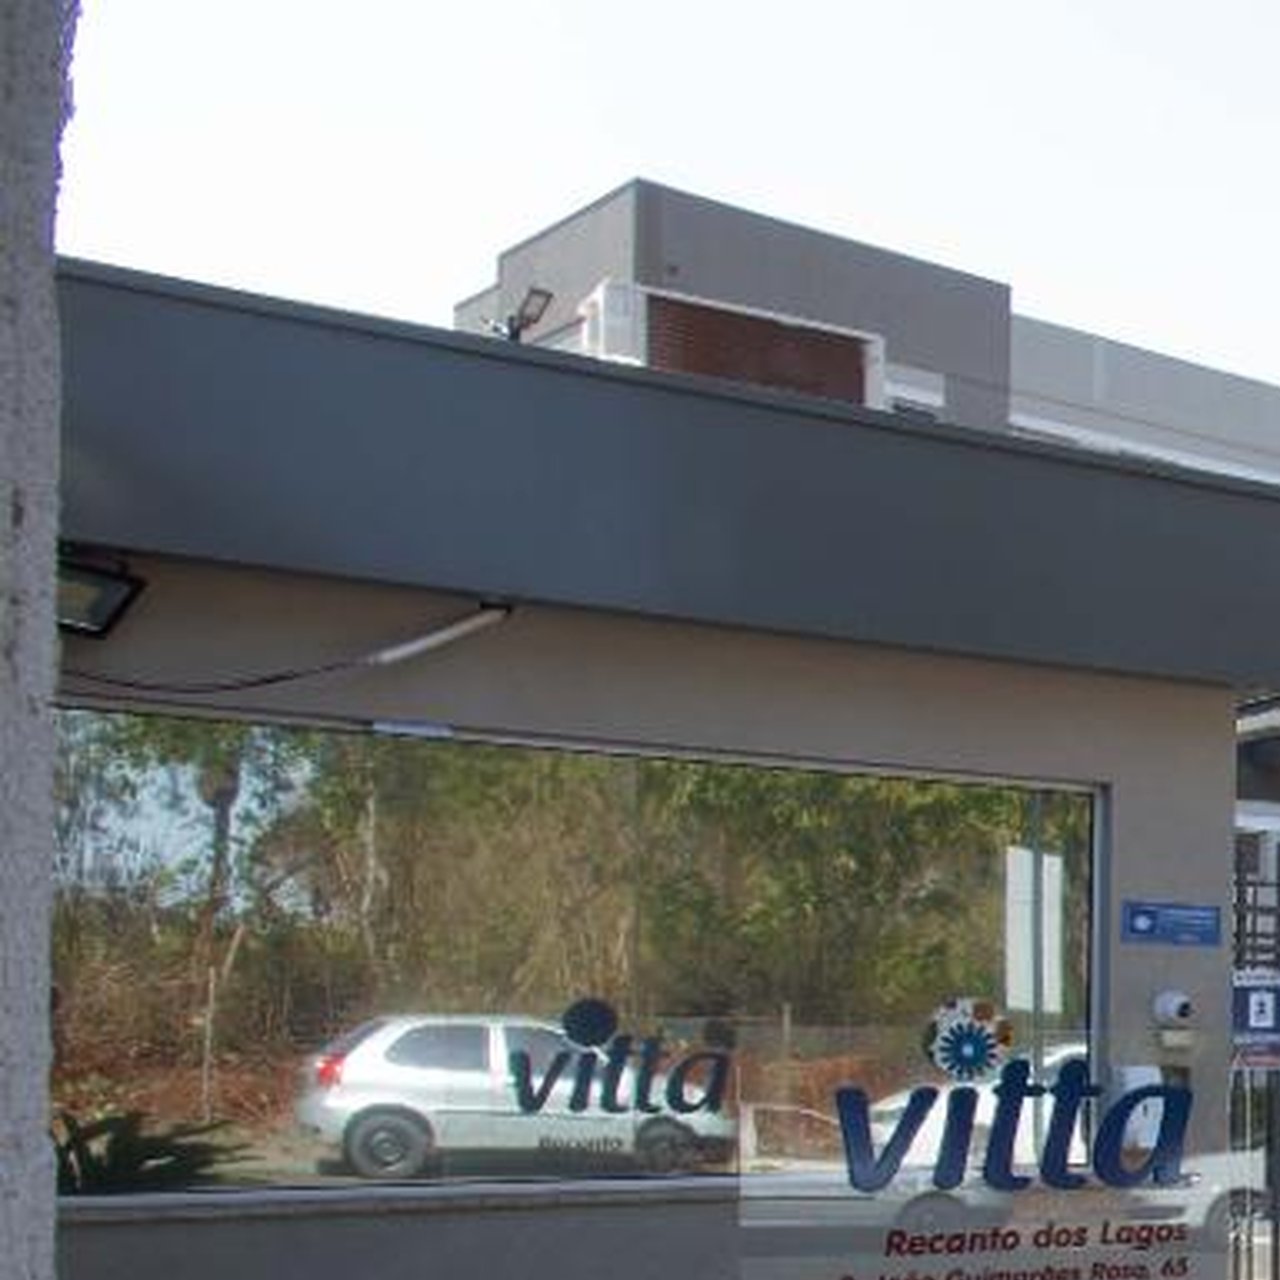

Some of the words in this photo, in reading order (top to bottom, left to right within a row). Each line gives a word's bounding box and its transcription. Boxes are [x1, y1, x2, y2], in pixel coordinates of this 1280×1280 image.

[510, 1000, 729, 1114] vitta
[836, 1000, 1193, 1193] vitta
[884, 1226, 1020, 1257] Recanto
[1033, 1221, 1088, 1250] dos
[1100, 1220, 1189, 1251] Lagos
[1160, 1256, 1188, 1277] 65
